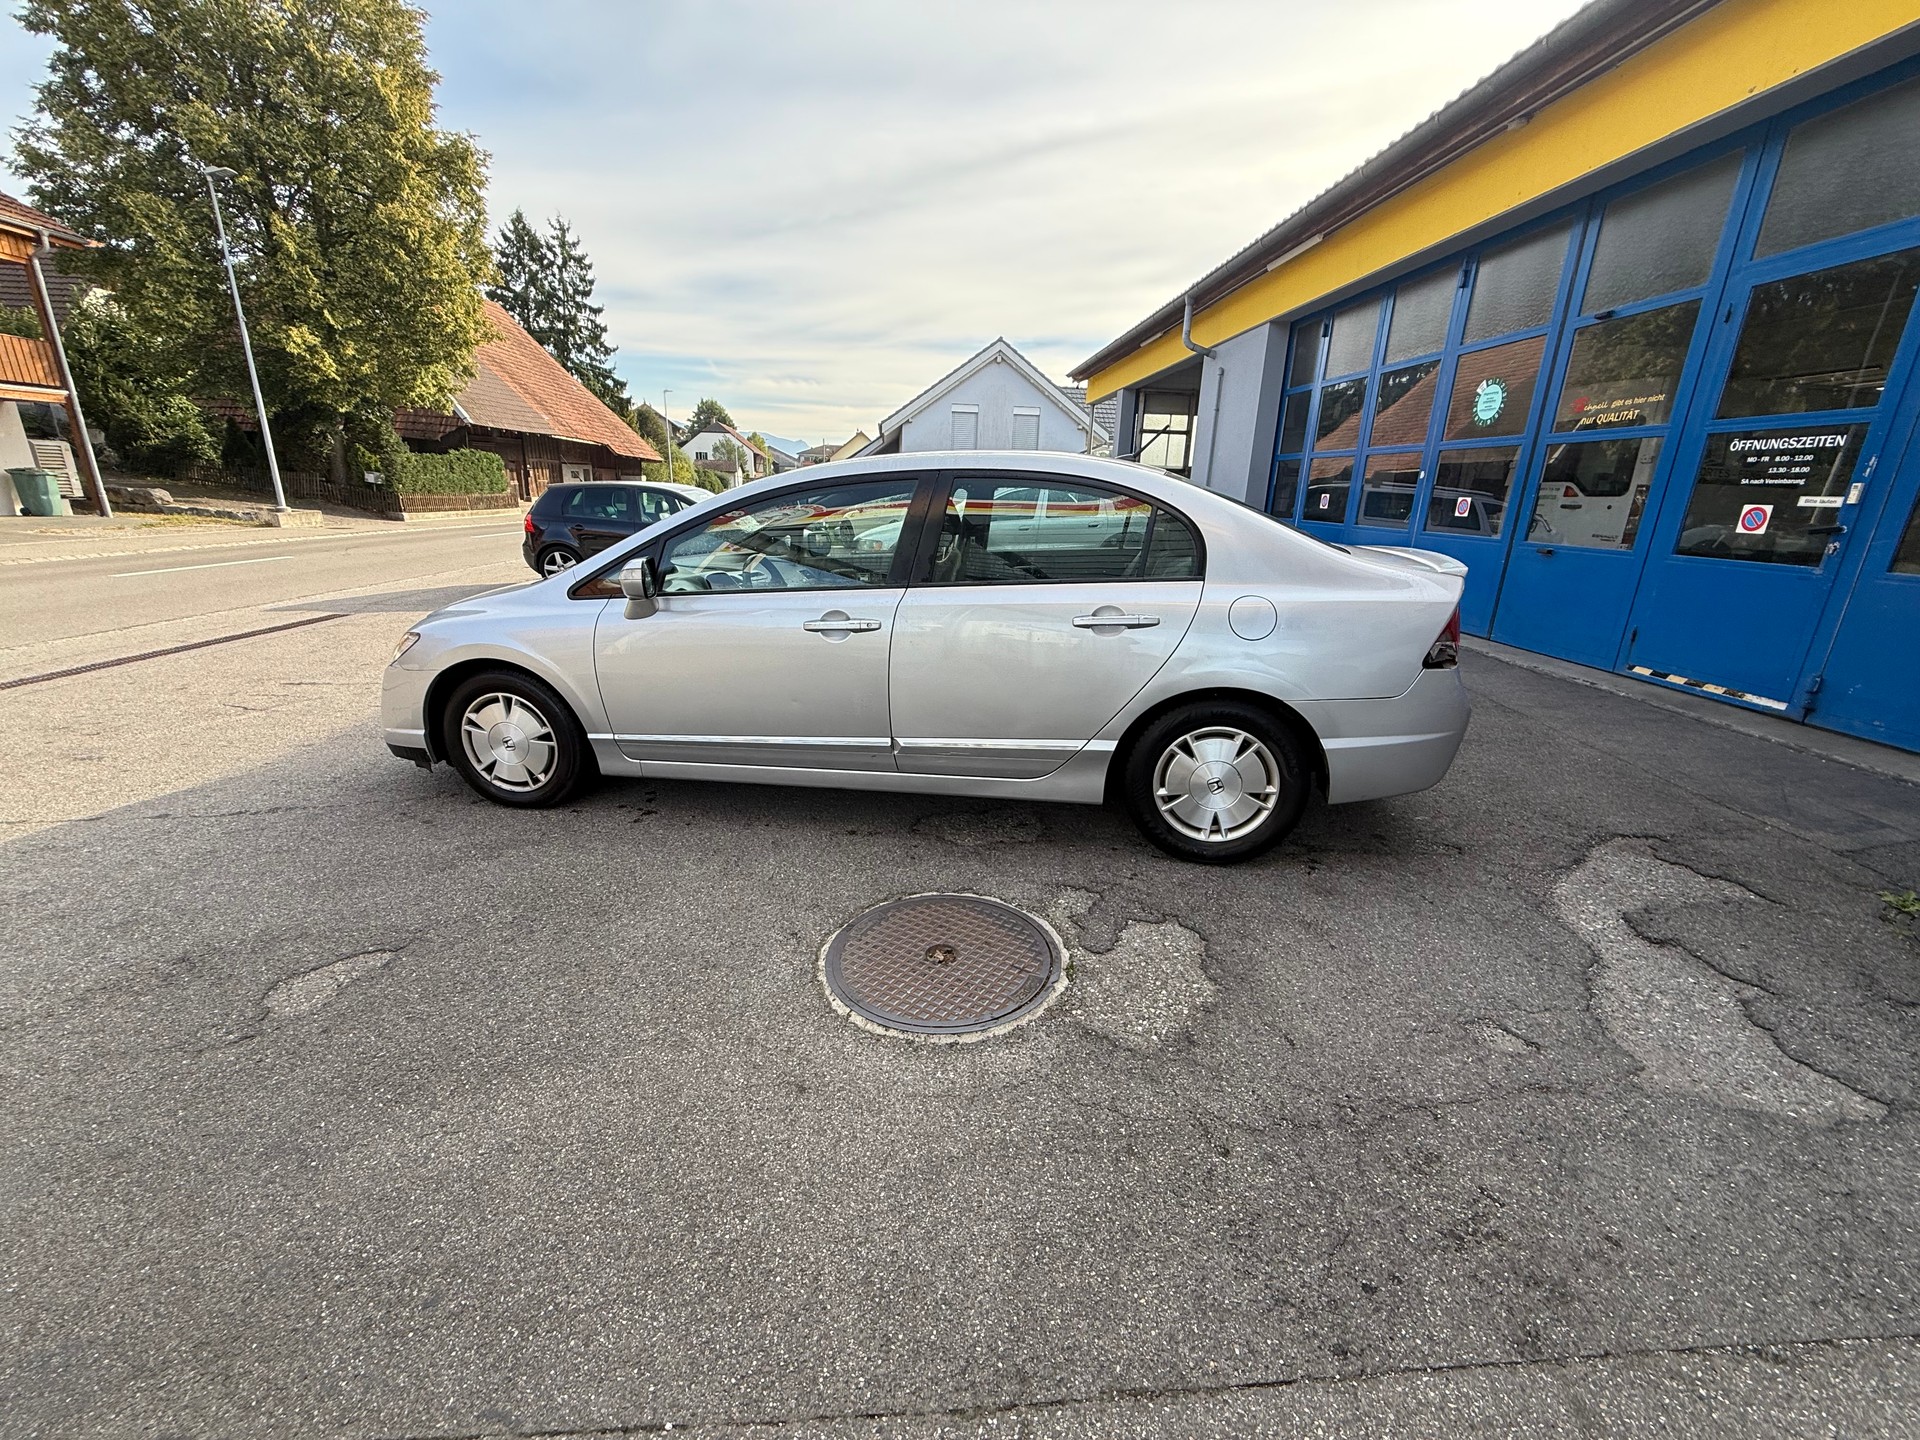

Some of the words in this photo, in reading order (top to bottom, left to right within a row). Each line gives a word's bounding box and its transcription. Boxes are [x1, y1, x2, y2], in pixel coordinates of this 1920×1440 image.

[1611, 400, 1624, 409] gibt
[1647, 394, 1665, 402] nicht
[1580, 417, 1596, 425] nur
[1597, 409, 1640, 424] QUALITÄT
[1730, 435, 1847, 451] ÖFFNUNGSZEITEN
